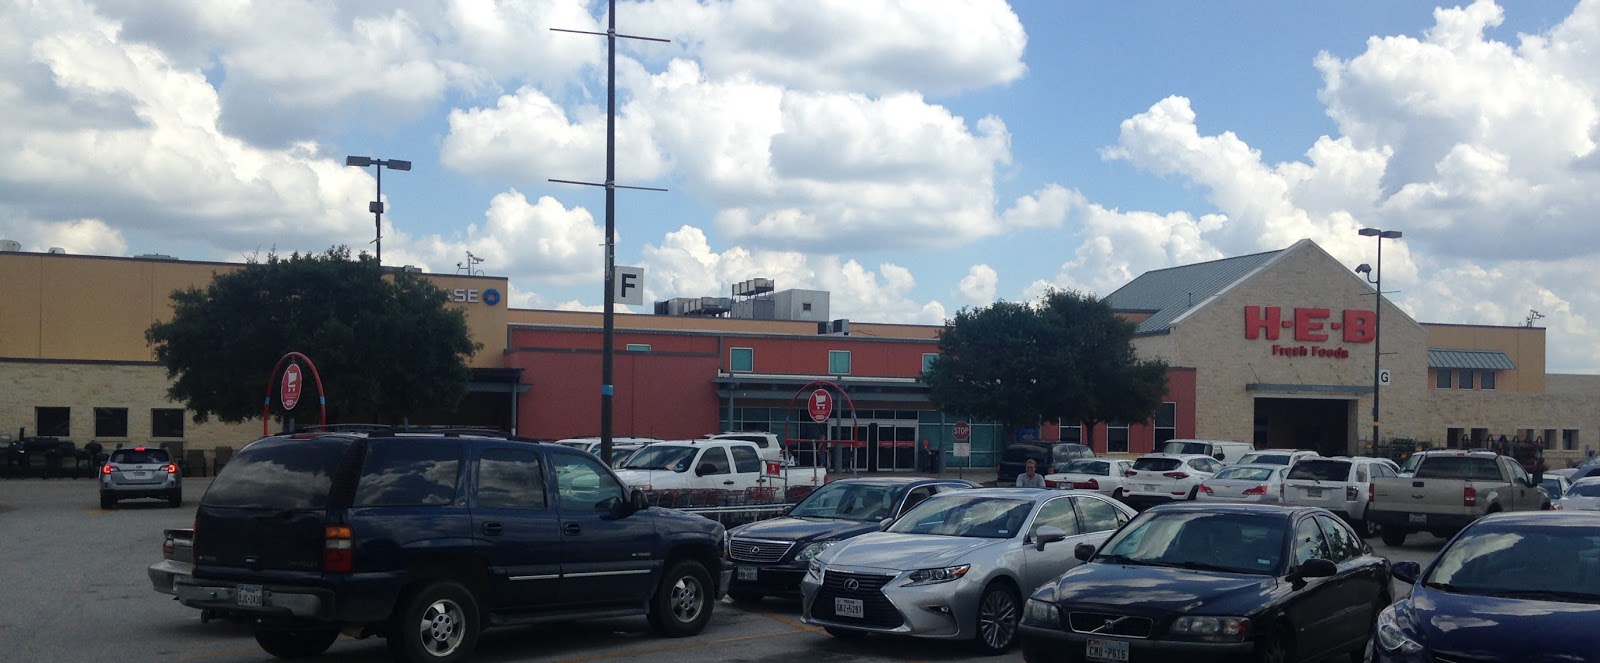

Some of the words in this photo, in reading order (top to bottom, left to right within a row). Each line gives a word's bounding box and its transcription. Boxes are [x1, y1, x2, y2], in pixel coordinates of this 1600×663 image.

[621, 273, 637, 298] F
[447, 288, 479, 303] SE
[1272, 344, 1308, 358] Fresh
[1311, 346, 1349, 359] Foods
[1380, 371, 1389, 383] G
[953, 427, 969, 435] STOP
